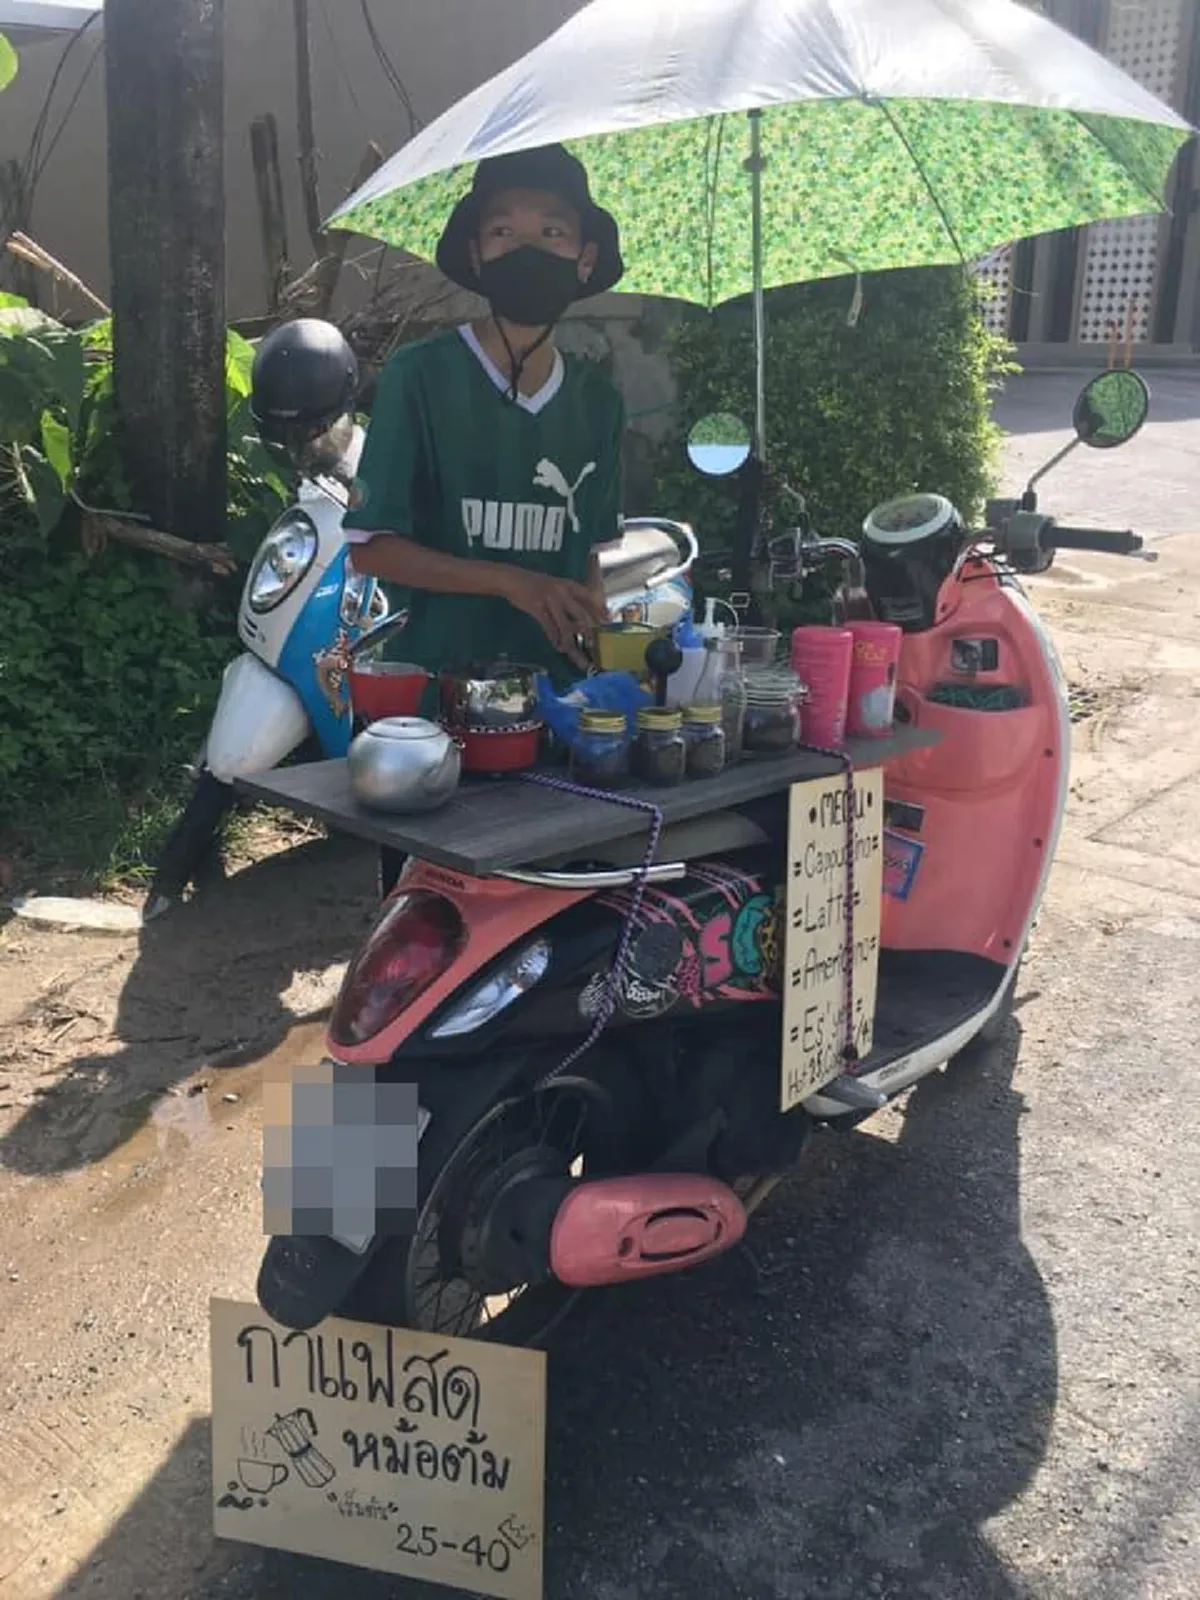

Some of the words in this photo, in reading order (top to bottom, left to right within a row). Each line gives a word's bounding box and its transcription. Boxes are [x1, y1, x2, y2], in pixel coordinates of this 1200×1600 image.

[461, 498, 566, 552] PUMA
[237, 1325, 480, 1427] กาแฟสด
[342, 1418, 510, 1490] หม้อต้ม
